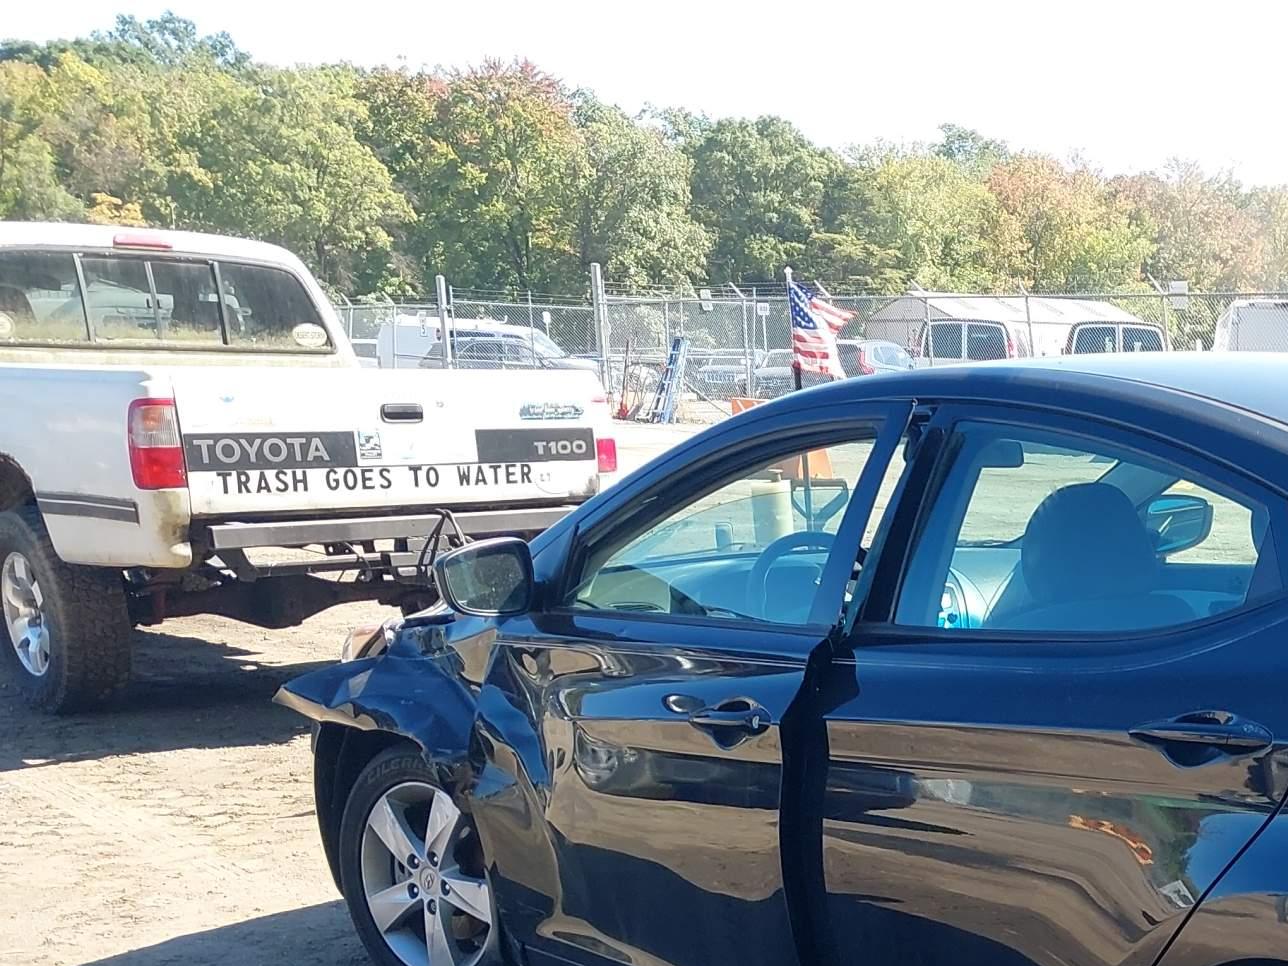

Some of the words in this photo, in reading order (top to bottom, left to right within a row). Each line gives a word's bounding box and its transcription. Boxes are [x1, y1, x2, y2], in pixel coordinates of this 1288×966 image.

[193, 437, 331, 464] TOYOTA
[533, 440, 587, 455] T100
[216, 469, 309, 494] TRASH
[325, 467, 392, 491] GOES
[408, 466, 440, 488] TO
[456, 463, 533, 486] WATER
